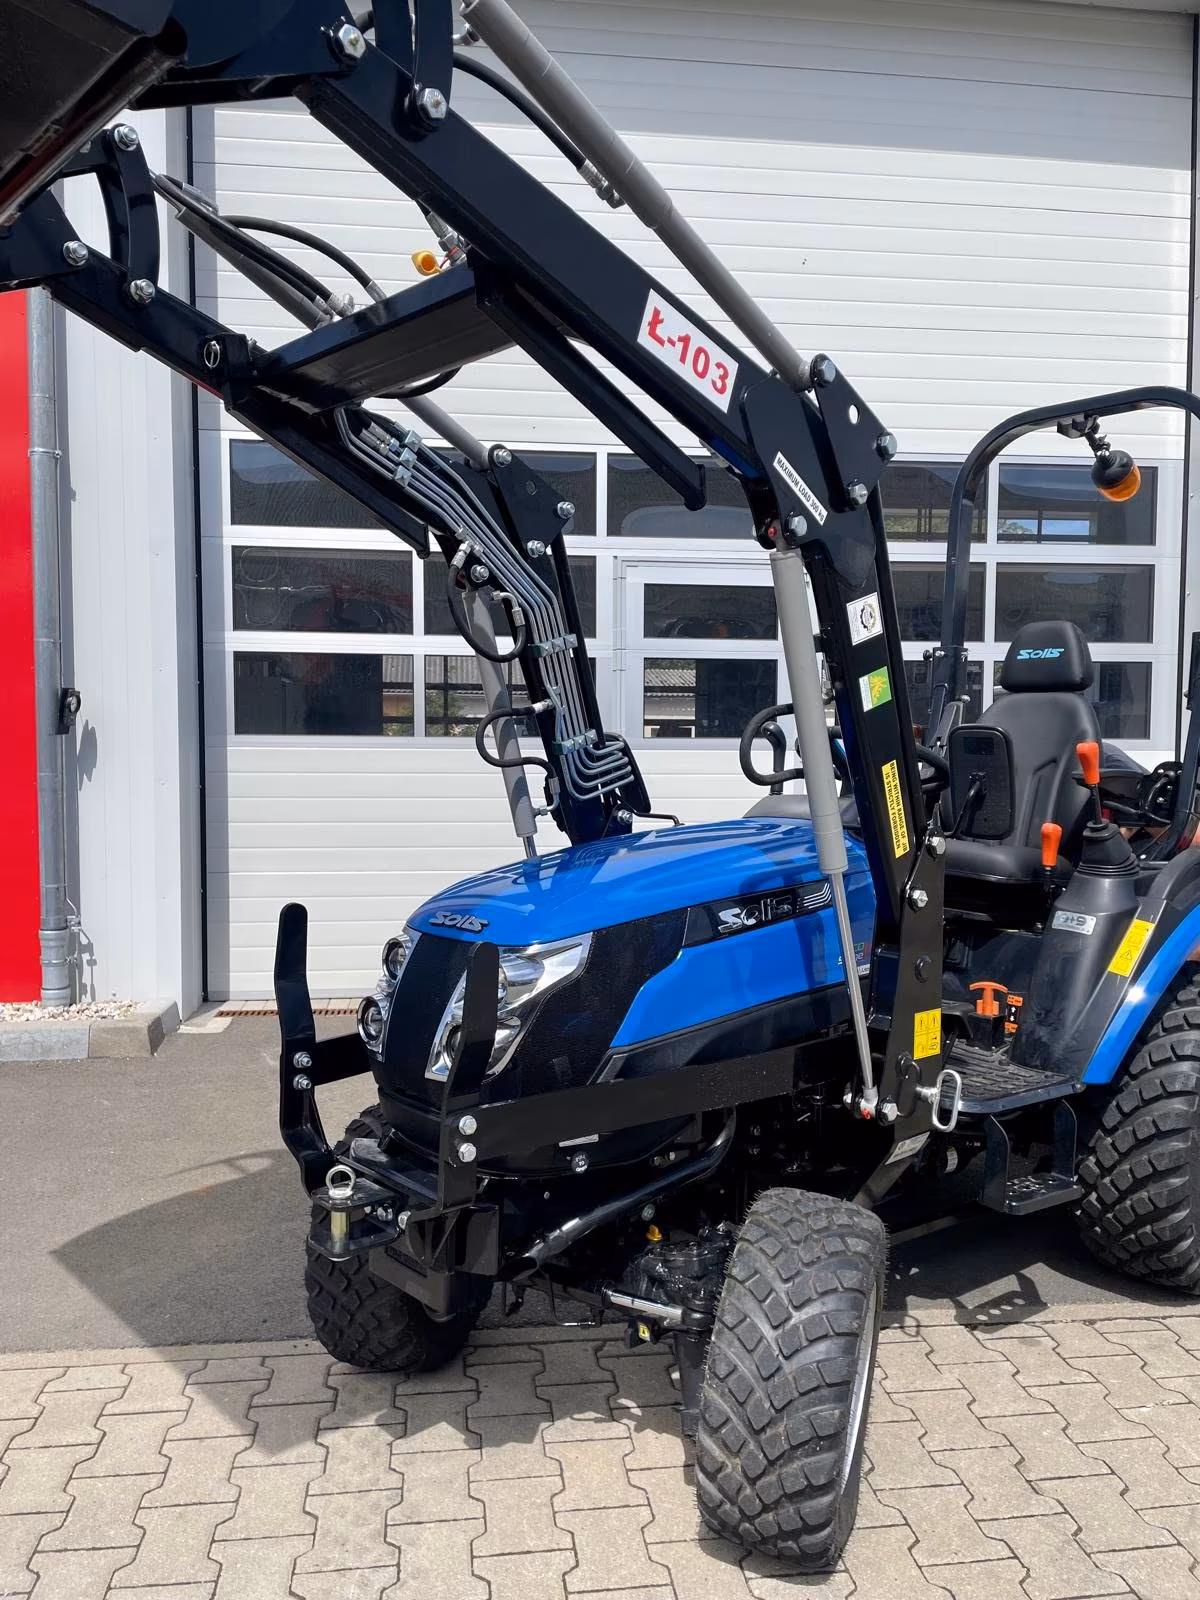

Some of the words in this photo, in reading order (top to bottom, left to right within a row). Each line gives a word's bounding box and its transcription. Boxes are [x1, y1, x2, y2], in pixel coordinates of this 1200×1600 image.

[647, 305, 730, 396] Ł-103
[777, 457, 800, 488] MAXIMUM
[799, 484, 811, 502] LOAD
[886, 780, 895, 811] STRICTLY
[891, 812, 901, 849] FORBIDDEN
[893, 784, 901, 807] WITHIN
